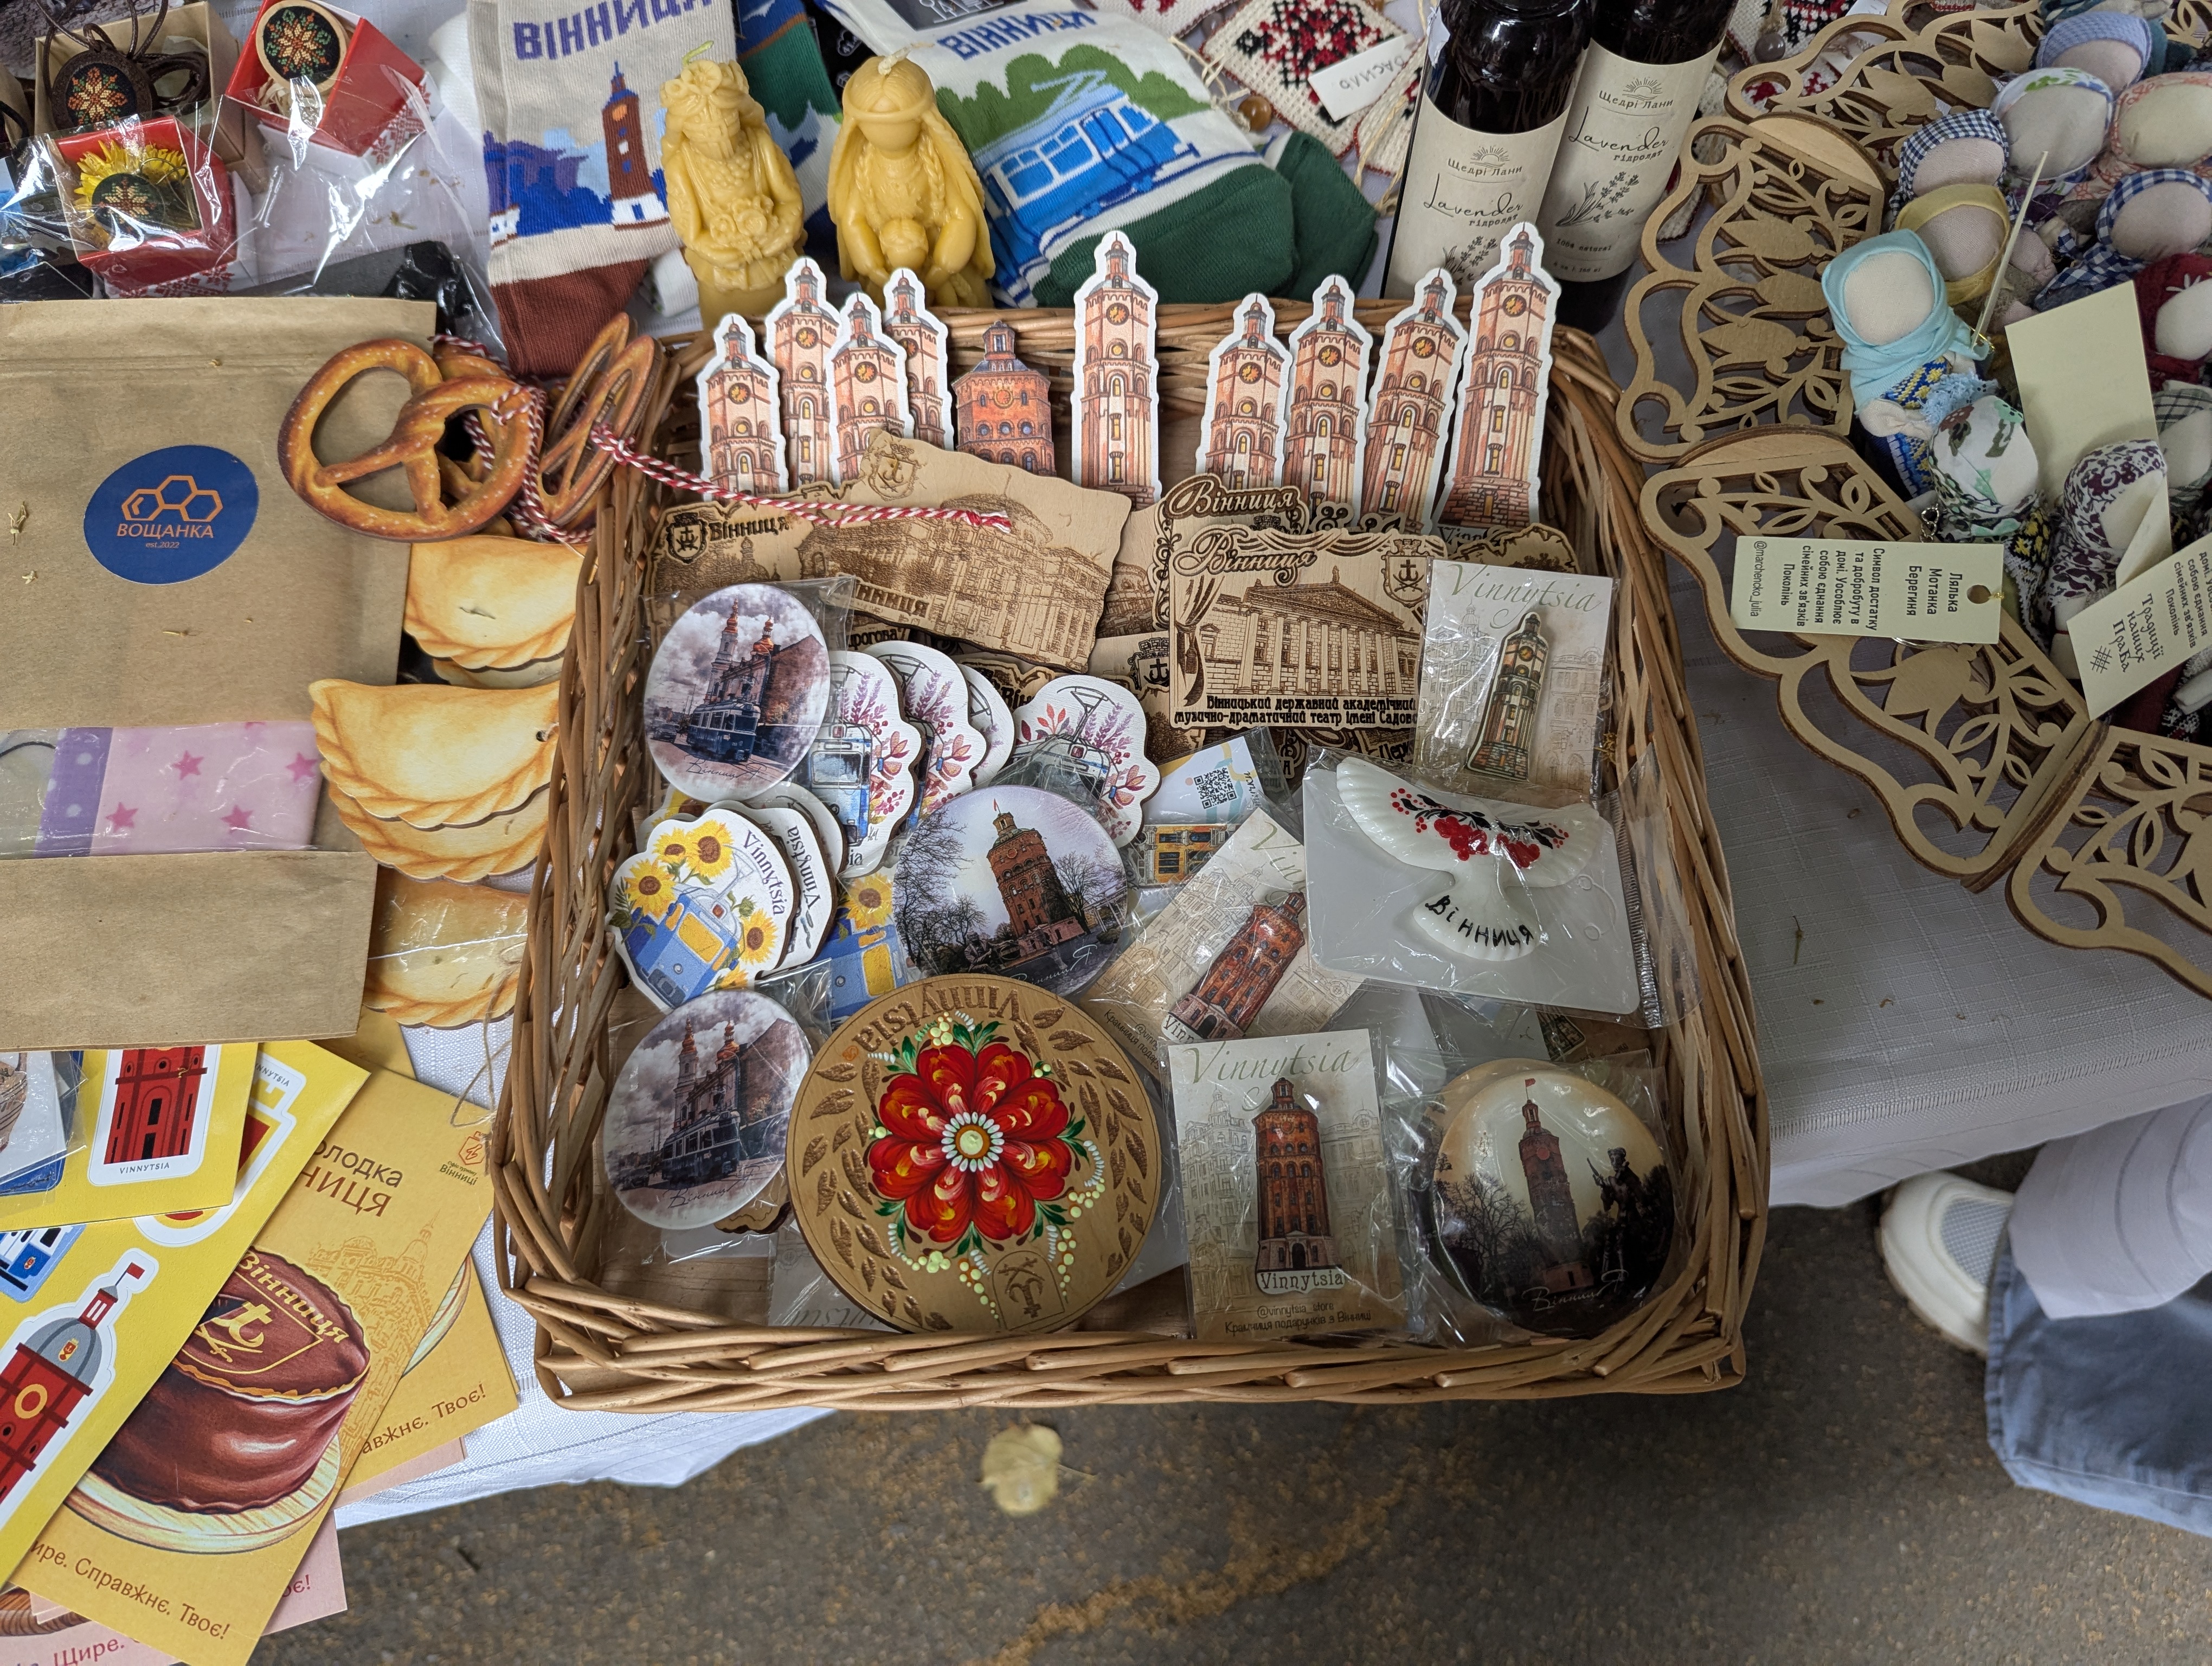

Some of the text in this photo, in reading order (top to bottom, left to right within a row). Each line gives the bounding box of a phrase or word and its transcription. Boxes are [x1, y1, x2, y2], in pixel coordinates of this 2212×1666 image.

[514, 0, 711, 60] ВІННИЦ
[937, 11, 1097, 61] ВІННИЦЯ
[1599, 90, 1674, 110] Щедрі Лани
[1568, 106, 1669, 152] Lavender
[1448, 158, 1522, 177] Щедрі Лани
[1613, 150, 1663, 163] гідролат
[1423, 173, 1523, 217] Lavender
[1468, 214, 1519, 228] гідролат
[1169, 479, 1294, 516] Вінниця
[117, 523, 214, 540] ВОЩАНКА
[708, 516, 790, 542] Вінниця
[1174, 528, 1318, 587] Вінниця
[1750, 540, 1768, 617] @marchencko_julia
[1854, 552, 1864, 563] та
[1448, 563, 1602, 629] Vinnytsia
[1780, 563, 1796, 606] Поколінь
[1796, 545, 1814, 627] сімейних зв'язків
[1814, 549, 1831, 624] собою єднання
[1832, 550, 1848, 625] домі. Уособлює
[1848, 565, 1865, 617] добробуту
[1865, 548, 1885, 631] Символ достатку
[1905, 565, 1922, 616] Берегиня
[1927, 568, 1943, 615] Мотанка
[1947, 572, 1963, 613] Лялька
[2174, 561, 2197, 649] сімейних зв'язків
[2187, 558, 2200, 592] собою
[2194, 593, 2208, 637] єднання
[2127, 610, 2145, 663] наших
[2136, 593, 2164, 661] Традиції
[2165, 588, 2181, 636] Поколінь
[1174, 710, 1307, 726] музично-драматичний
[1310, 712, 1342, 726] театр
[1346, 710, 1376, 726] імені
[1206, 695, 1417, 712] Вінницький державний академічний
[743, 829, 787, 916] Vinnytsia
[787, 825, 821, 911] Vinnytsia
[852, 982, 1020, 1053] Vinnytsia
[1104, 1009, 1140, 1046] Крамниця
[1182, 1040, 1360, 1112] Vinnytsia
[120, 1162, 170, 1174] VINNYTSIA
[313, 1139, 403, 1188] олодка
[439, 1164, 479, 1186] Вінниці
[301, 1166, 393, 1218] НИЦЯ
[238, 1250, 350, 1344] Вінниця
[1260, 1269, 1344, 1291] Vinnytsia
[1224, 1310, 1372, 1337] Крамниця подарунків з Вінниці
[1257, 1302, 1335, 1319] @vinnytsia_store
[363, 1383, 486, 1454] авжнє. Твоє!
[31, 1540, 230, 1640] ире. Справжнє. Твоє!
[281, 1574, 311, 1598] оє!
